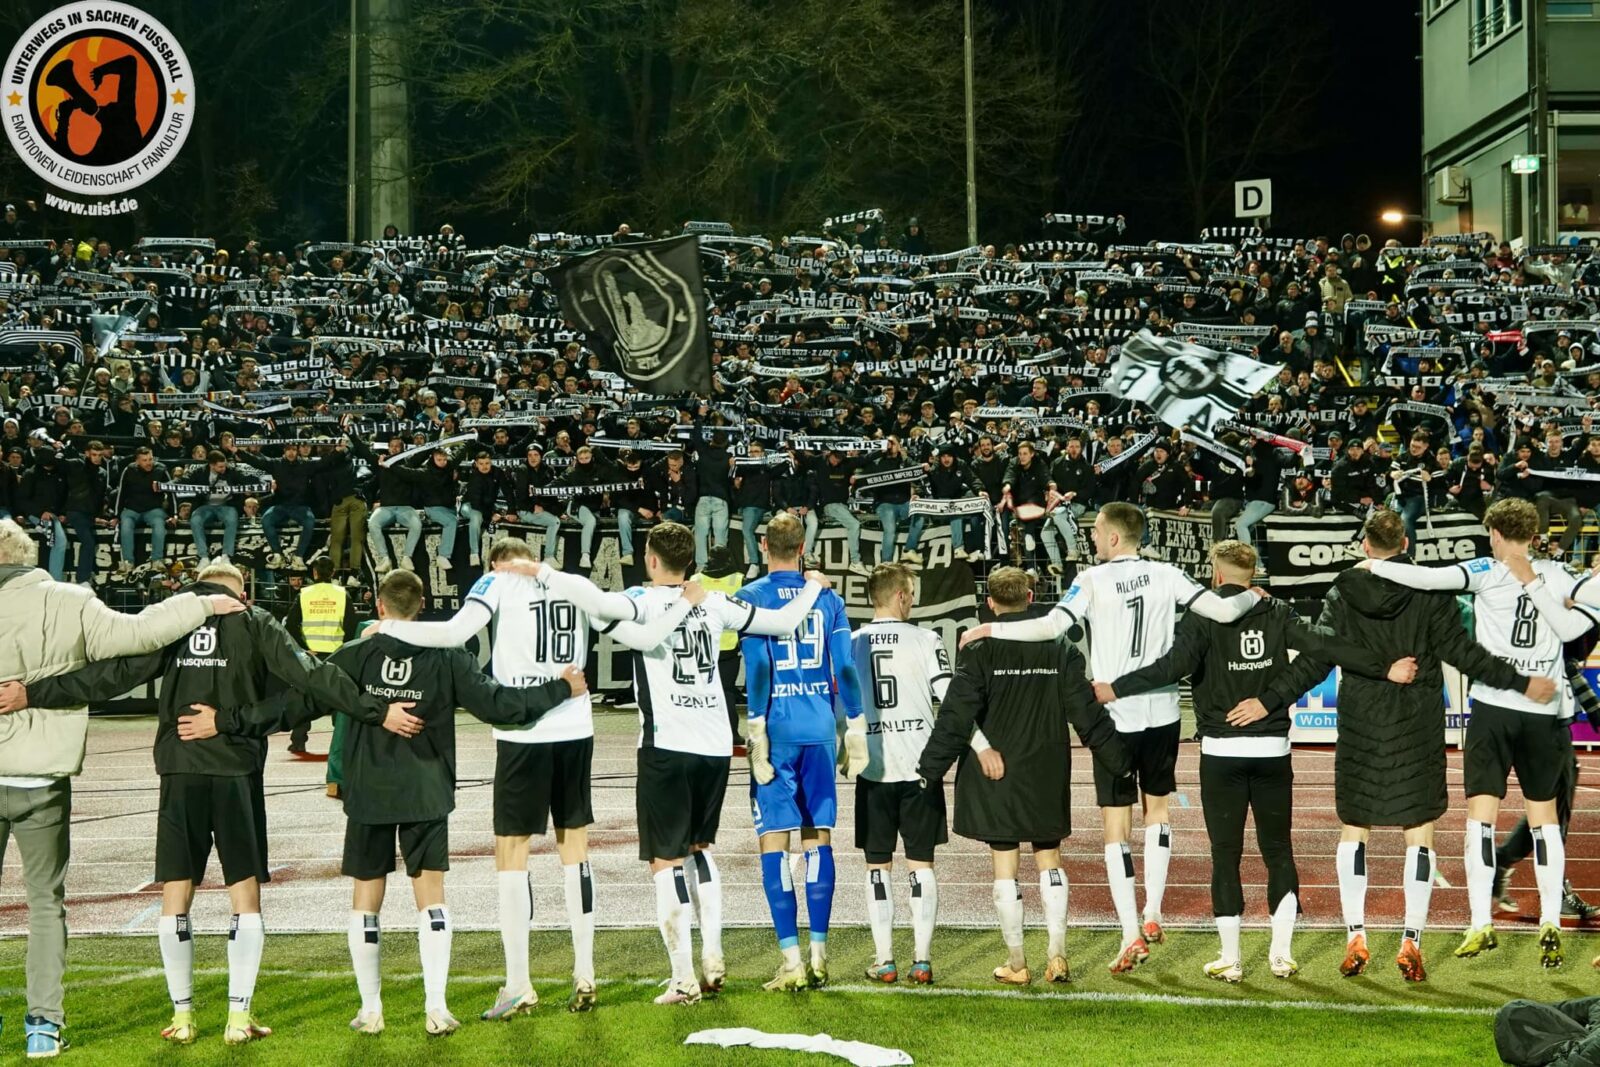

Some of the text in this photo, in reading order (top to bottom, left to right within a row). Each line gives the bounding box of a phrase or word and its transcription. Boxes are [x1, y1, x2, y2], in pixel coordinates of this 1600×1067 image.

[1241, 186, 1264, 211] D
[959, 309, 977, 317] SSV
[979, 311, 1000, 320] ULM
[1448, 312, 1508, 323] 1846
[889, 360, 958, 372] ULMER
[1040, 366, 1111, 378] ULMER
[1390, 375, 1453, 387] 1846
[31, 395, 109, 410] ULMER
[867, 474, 894, 485] NEBULOSA
[894, 470, 913, 482] IMPERO
[589, 481, 639, 494] SOCIETY
[1166, 519, 1193, 536] EINE
[1165, 532, 1196, 549] LANG
[1177, 548, 1200, 564] RAD
[1126, 595, 1144, 658] 1
[1510, 593, 1539, 649] 8
[528, 599, 577, 664] 18
[868, 633, 899, 645] GEYER
[870, 649, 898, 710] 6
[802, 681, 831, 696] UTZ
